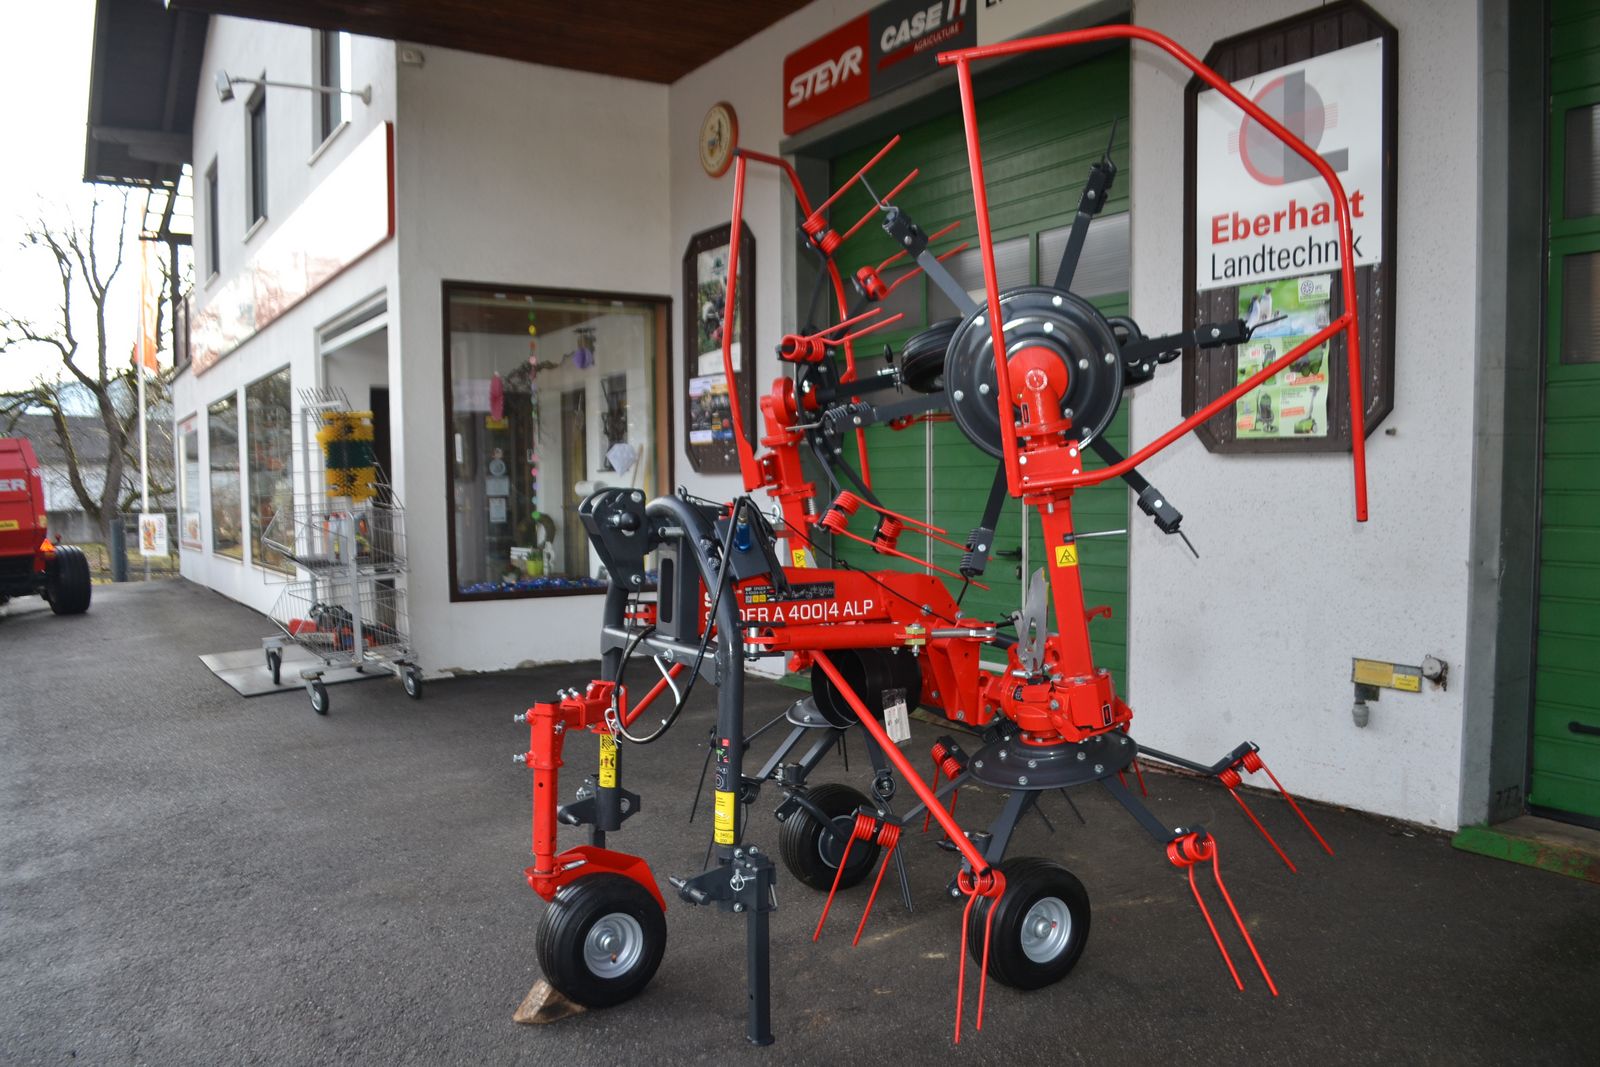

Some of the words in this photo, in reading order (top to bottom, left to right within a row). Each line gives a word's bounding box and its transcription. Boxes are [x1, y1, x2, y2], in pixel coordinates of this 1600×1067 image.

[881, 2, 943, 53] CASE
[913, 23, 959, 53] AGRICULTURE
[788, 45, 863, 107] STEYR
[1211, 229, 1363, 281] Landtechnk
[774, 606, 785, 622] A
[843, 599, 873, 617] ALP
